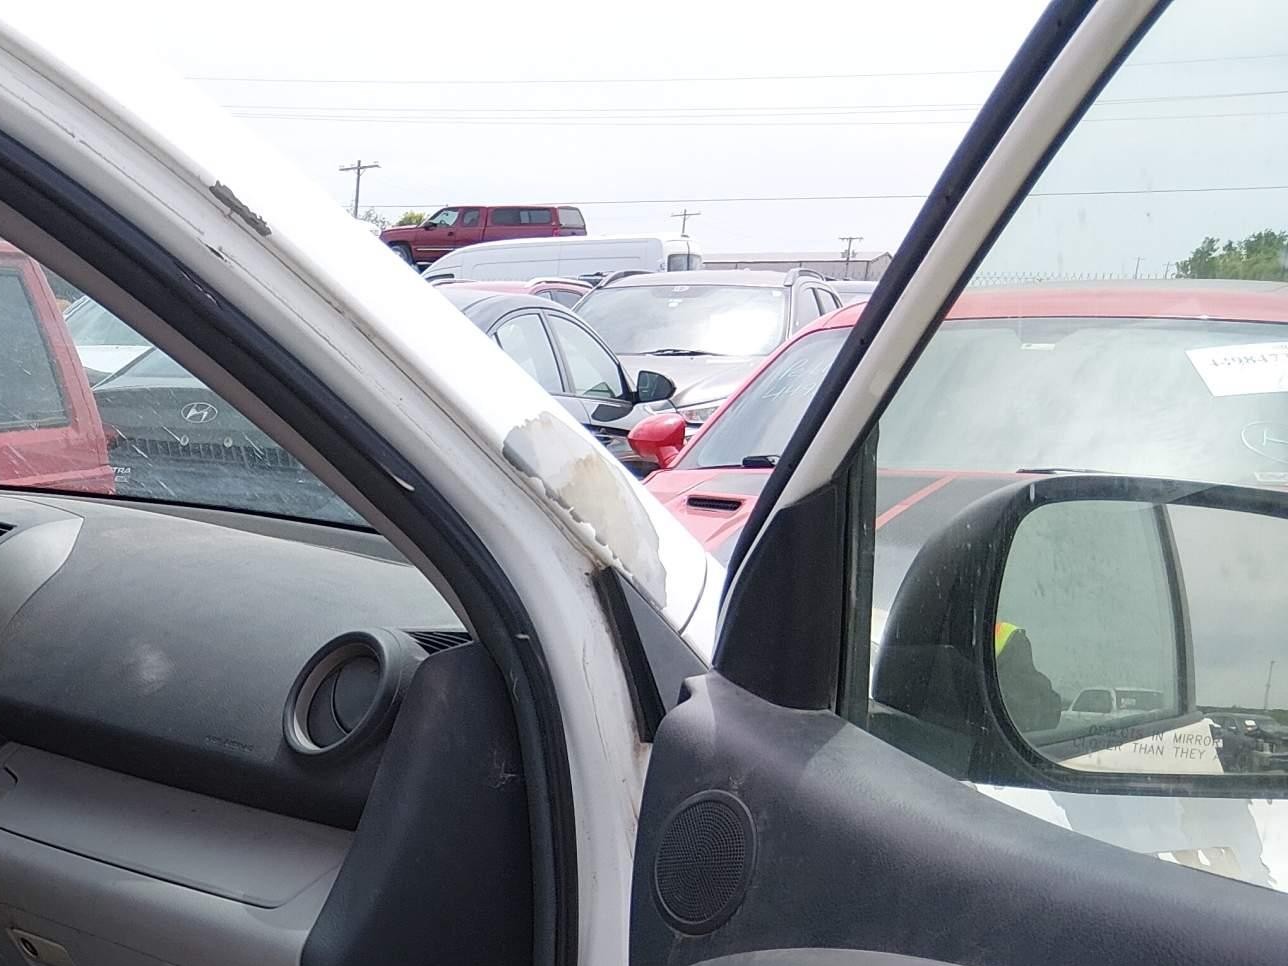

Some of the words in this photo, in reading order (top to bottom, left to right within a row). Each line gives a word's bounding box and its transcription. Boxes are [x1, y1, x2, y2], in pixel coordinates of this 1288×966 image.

[1151, 730, 1164, 742] IN
[1133, 742, 1164, 757] THAN
[1174, 746, 1206, 760] THEY
